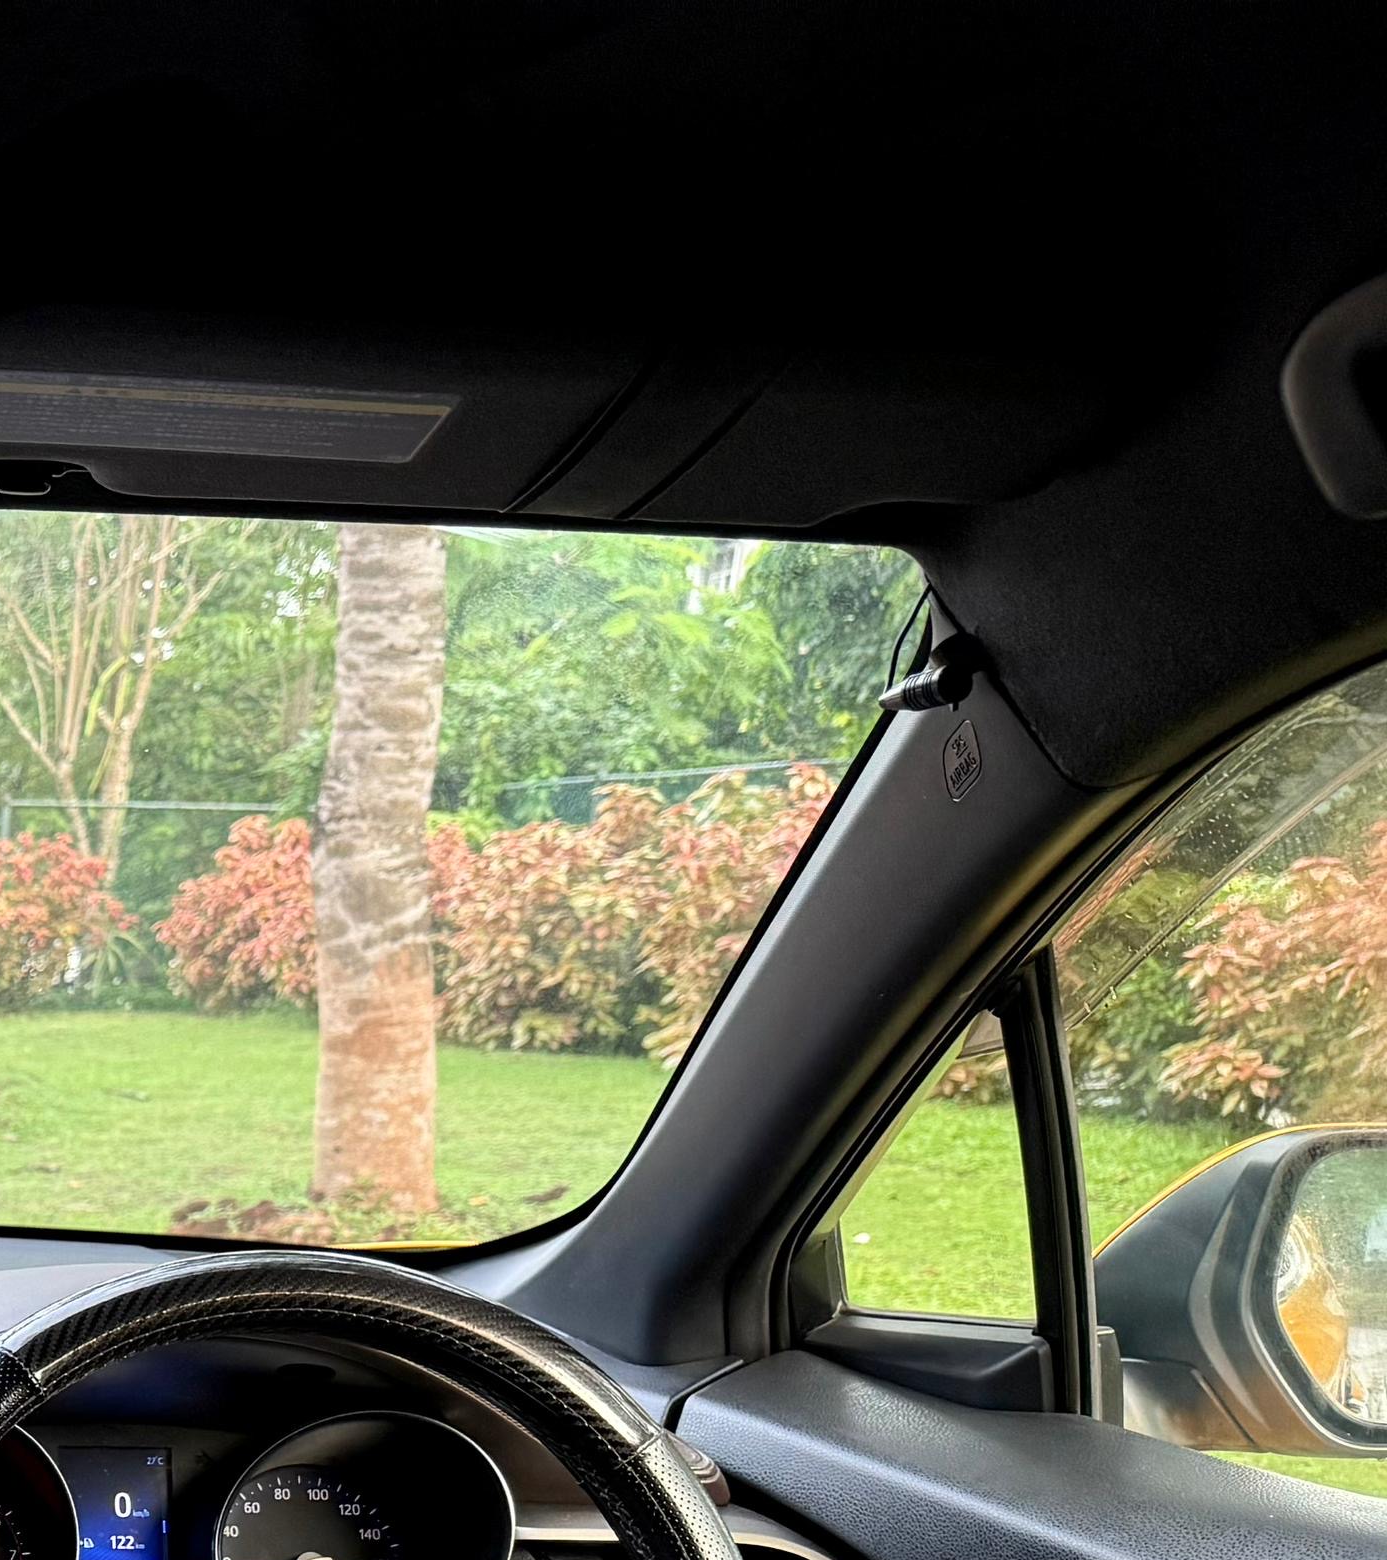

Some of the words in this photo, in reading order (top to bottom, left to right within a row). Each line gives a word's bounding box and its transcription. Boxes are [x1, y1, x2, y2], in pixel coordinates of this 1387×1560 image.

[948, 751, 978, 789] AIRBAG
[274, 1488, 291, 1500] 80
[307, 1488, 329, 1501] 100
[113, 1492, 132, 1518] 0
[244, 1502, 261, 1514] 60
[338, 1503, 361, 1516] 120
[223, 1525, 239, 1538] 40
[359, 1528, 381, 1541] 140
[109, 1535, 135, 1550] 122
[9, 1549, 17, 1560] 7
